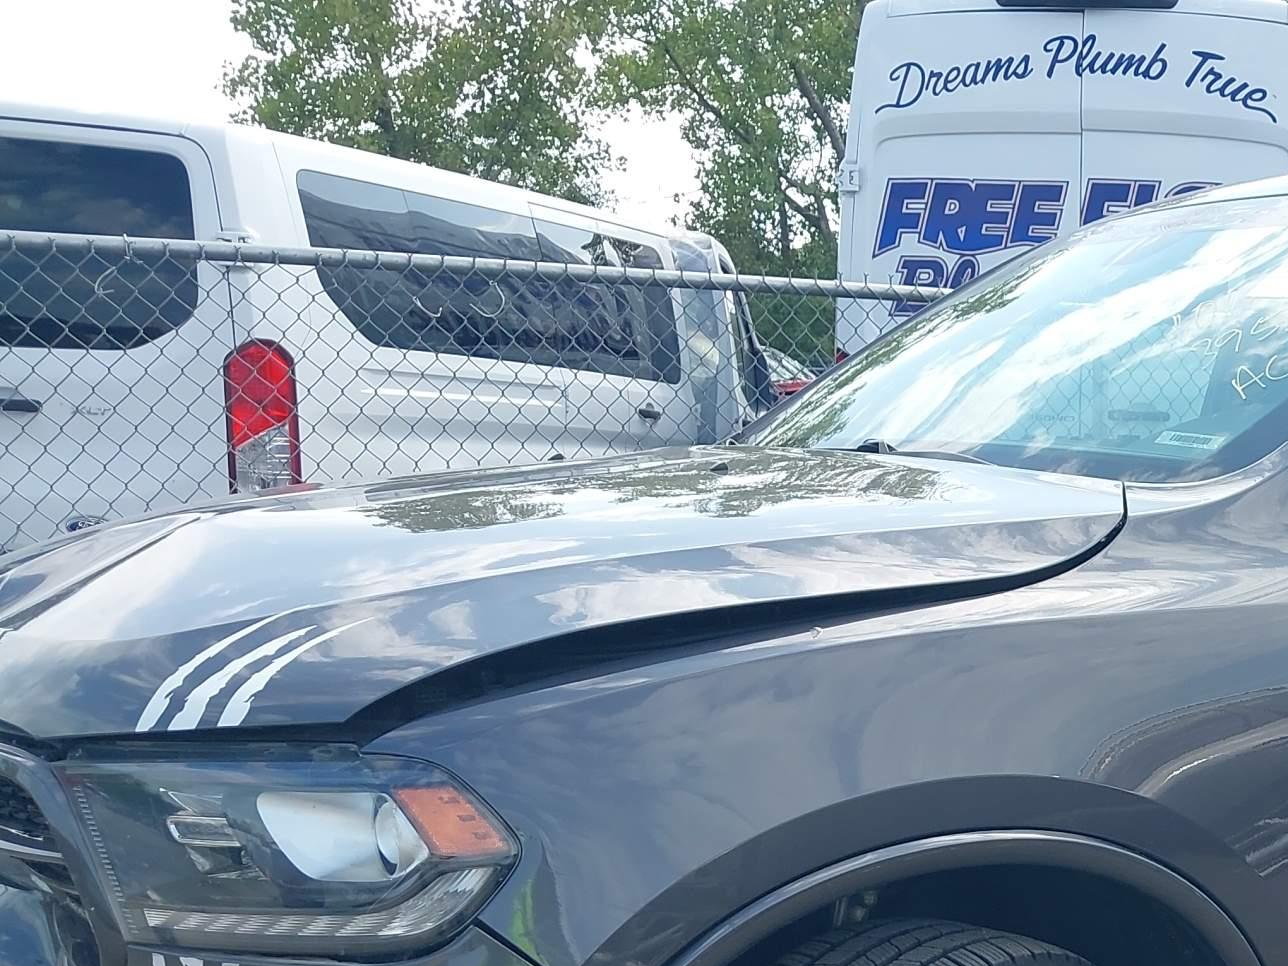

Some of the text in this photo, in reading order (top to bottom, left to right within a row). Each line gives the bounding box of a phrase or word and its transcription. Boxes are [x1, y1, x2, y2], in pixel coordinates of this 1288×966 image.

[875, 33, 1278, 123] Dreams Plumb True
[872, 177, 1069, 258] FREE
